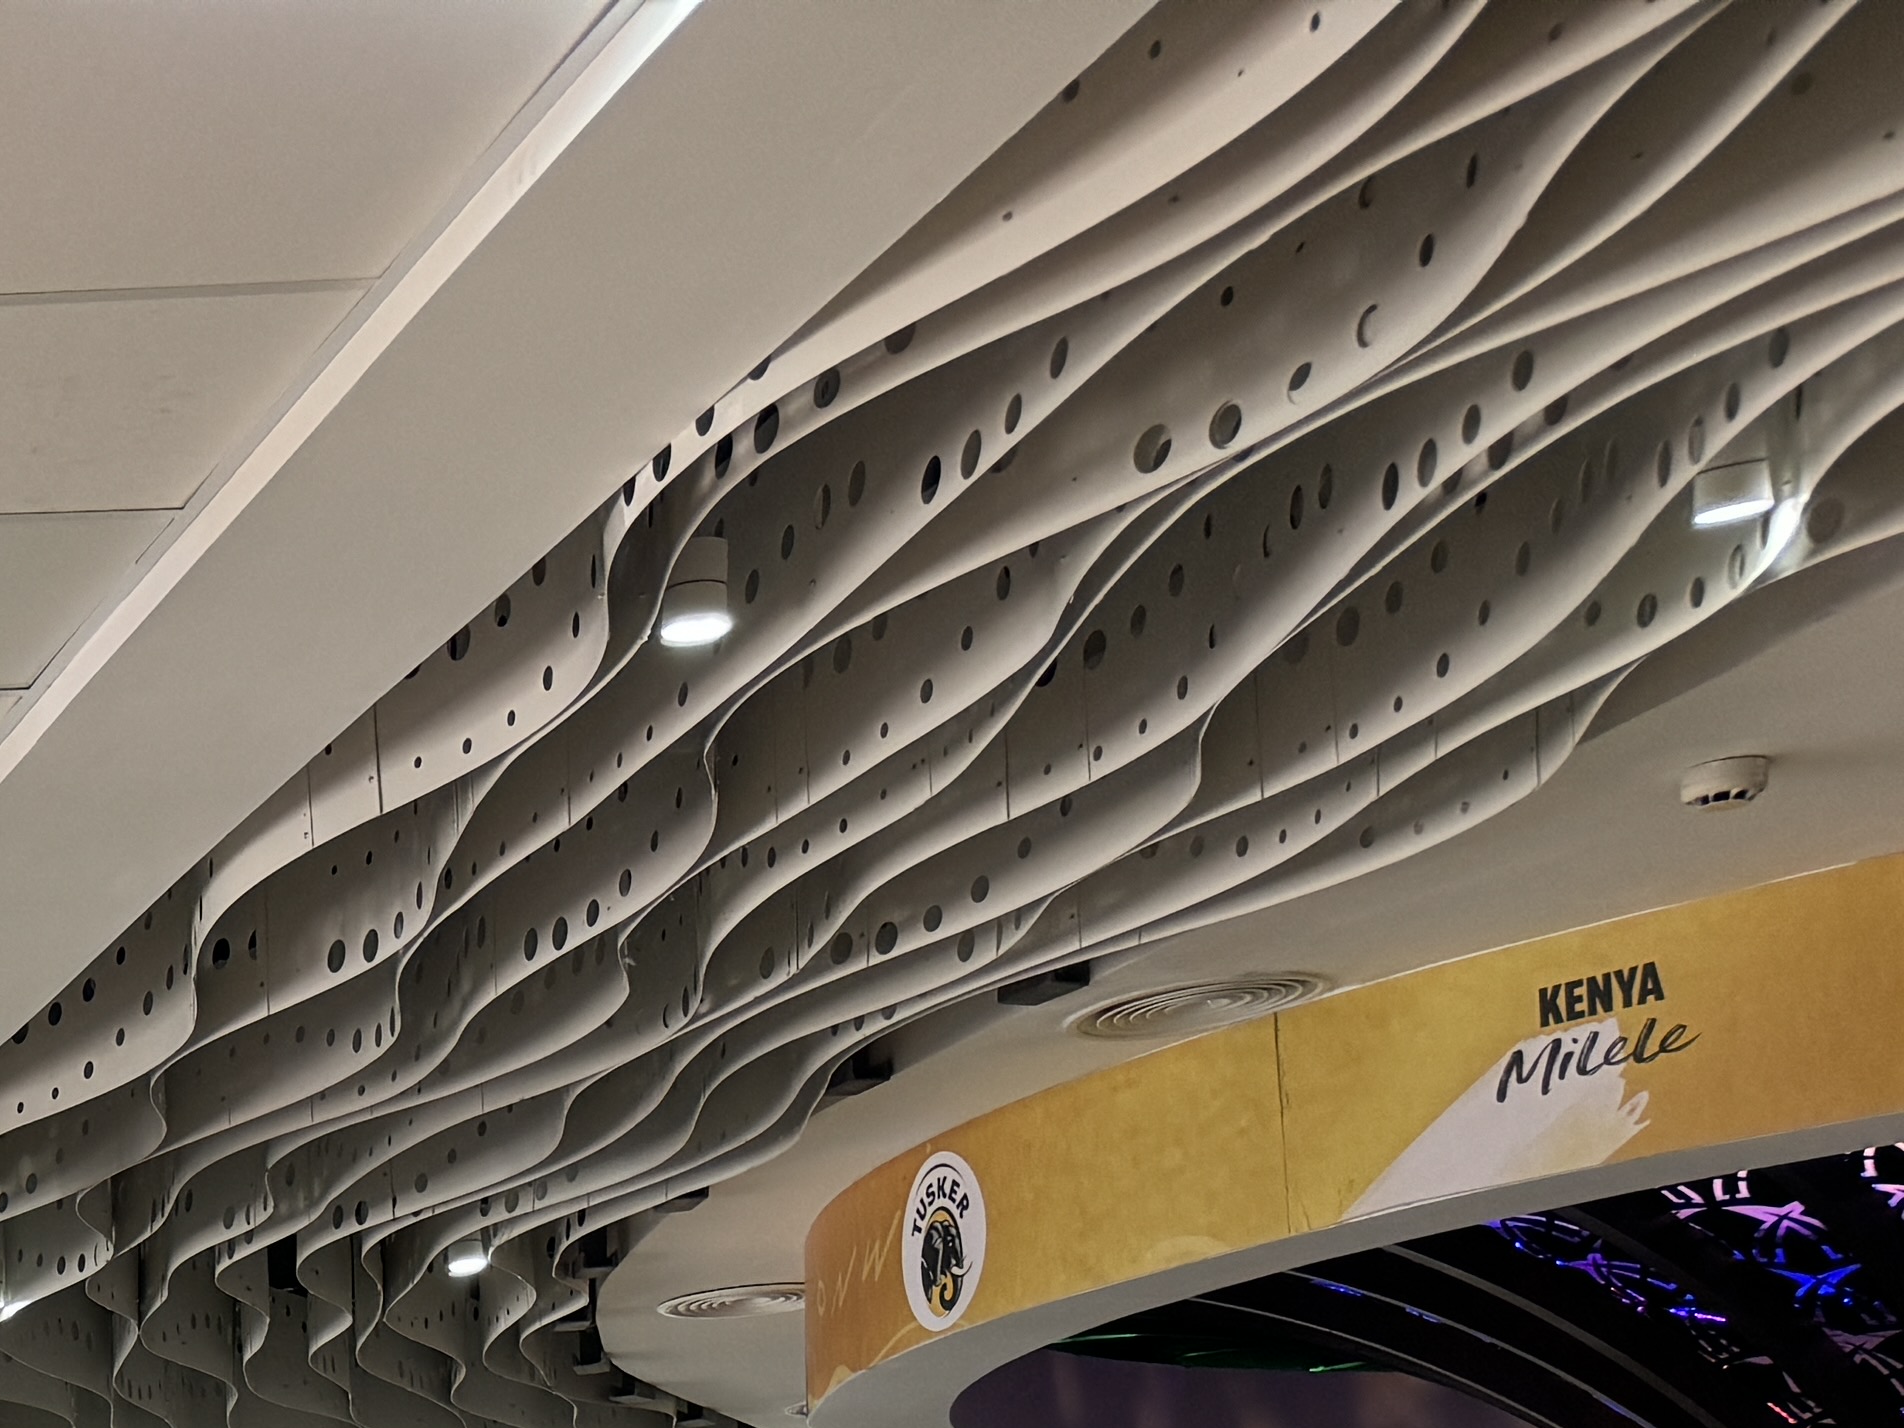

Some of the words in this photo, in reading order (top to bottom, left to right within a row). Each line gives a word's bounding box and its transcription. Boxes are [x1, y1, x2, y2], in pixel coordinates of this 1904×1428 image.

[1538, 960, 1666, 1029] KENYA
[1498, 1017, 1702, 1104] Milele
[910, 1175, 971, 1238] TUSKER
